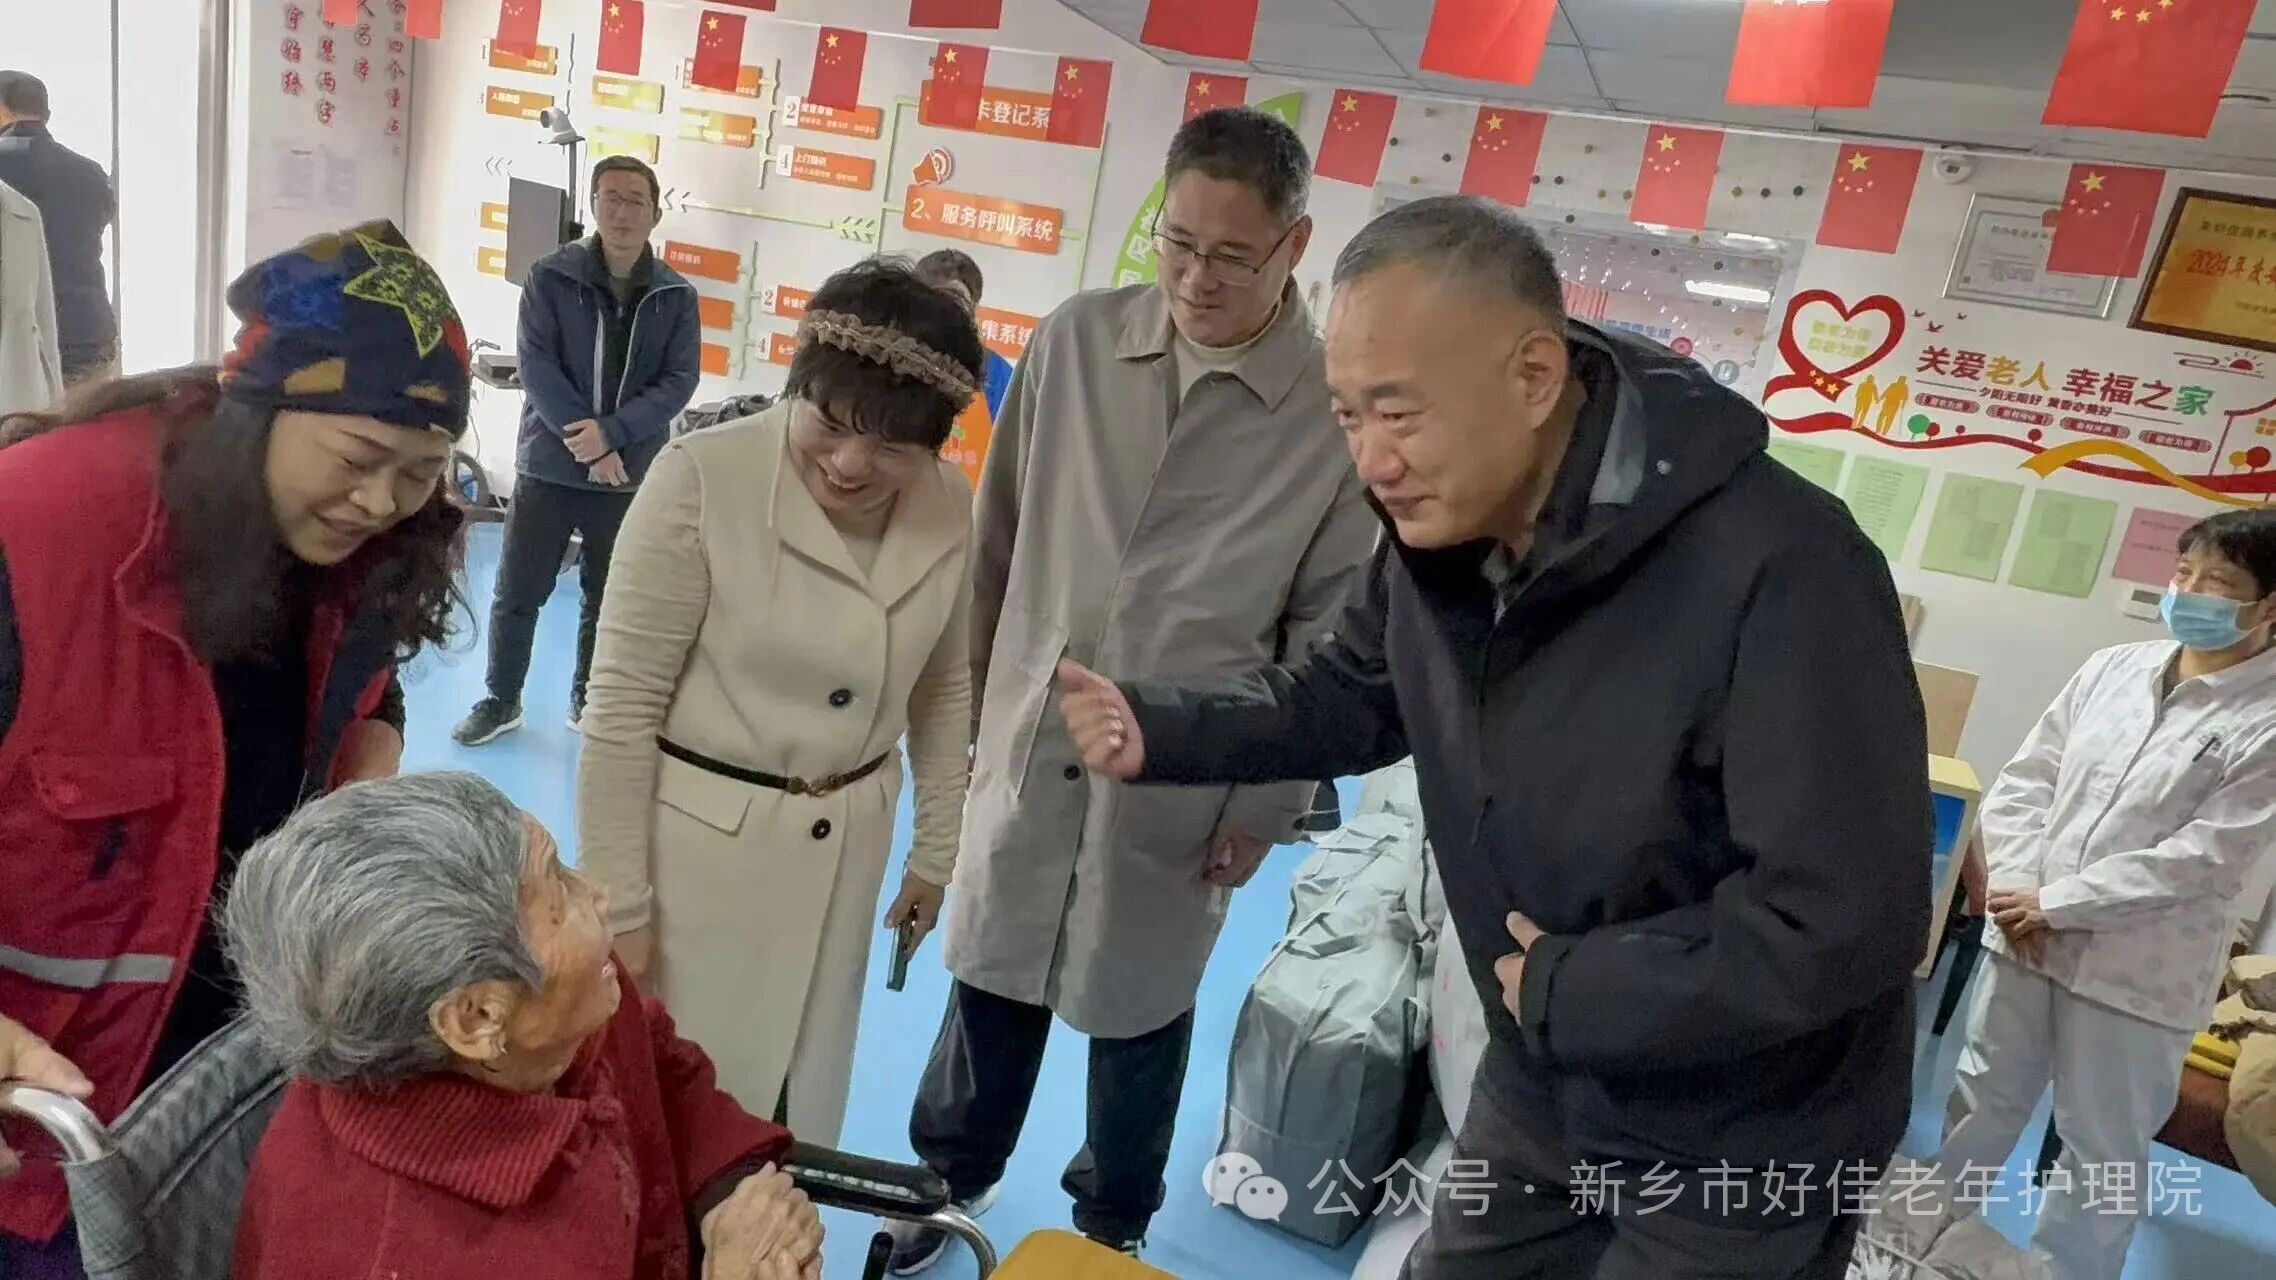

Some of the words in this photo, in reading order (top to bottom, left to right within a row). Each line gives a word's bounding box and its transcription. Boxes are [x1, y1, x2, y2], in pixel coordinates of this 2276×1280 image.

[911, 197, 1054, 243] 2、服务呼叫系统
[1917, 344, 2050, 392] 关爱老人
[2062, 368, 2215, 417] 幸福之家
